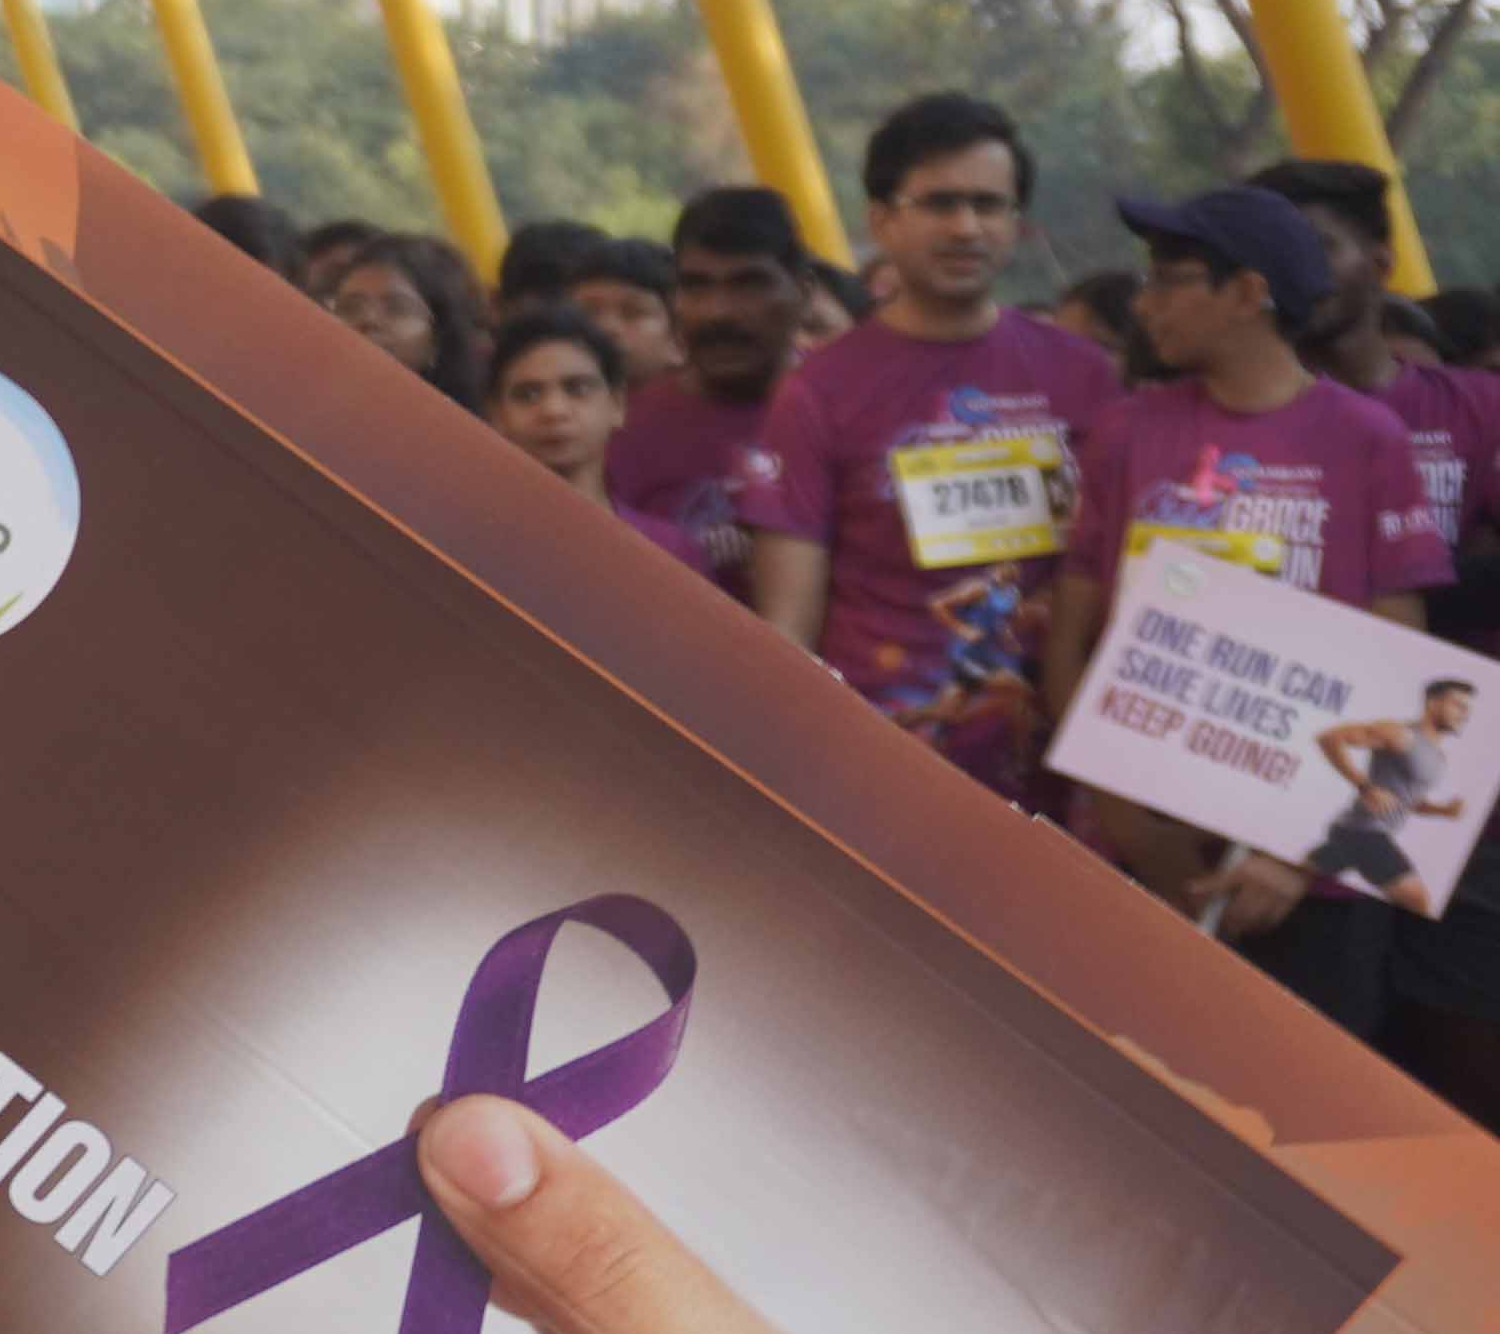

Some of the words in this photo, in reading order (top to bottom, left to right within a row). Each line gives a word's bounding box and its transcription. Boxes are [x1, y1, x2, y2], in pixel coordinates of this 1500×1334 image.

[1117, 645, 1204, 704] SAVE
[1201, 678, 1300, 742] LIVES
[1136, 606, 1204, 658] ONE
[1208, 632, 1279, 686] RUN
[1278, 662, 1353, 716] CAN
[1099, 683, 1186, 742] KEEP
[1188, 717, 1304, 791] GOING!
